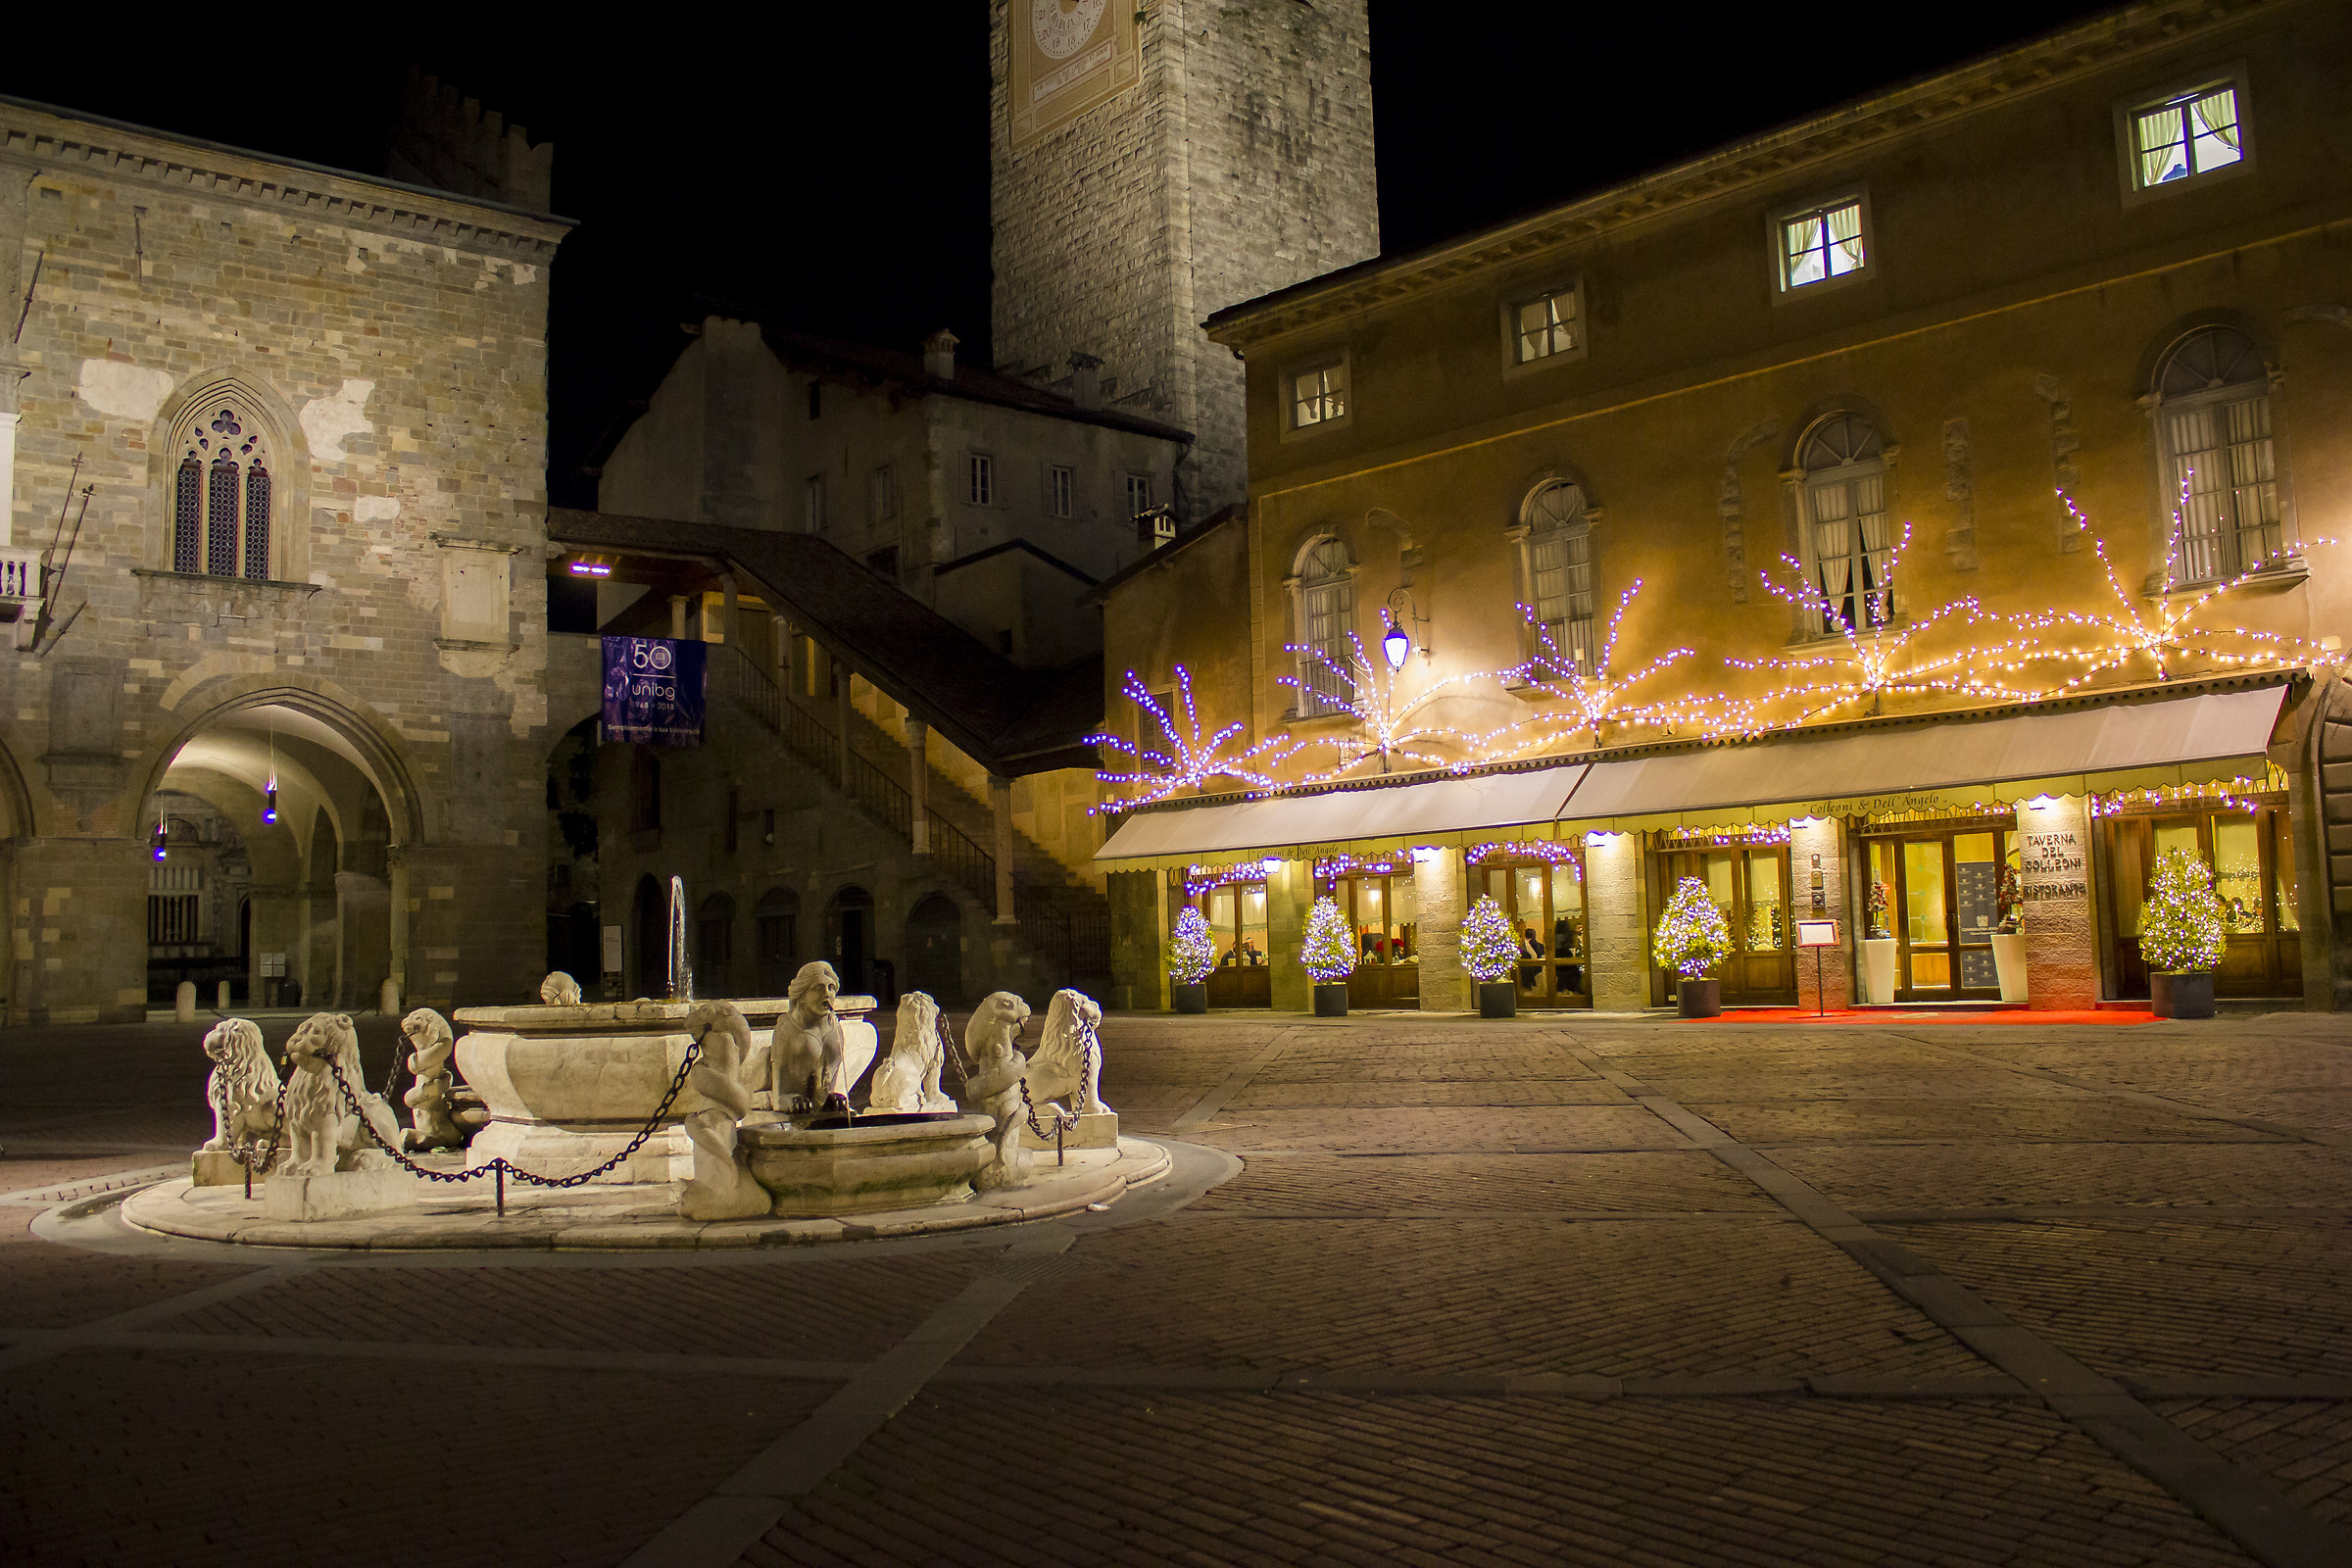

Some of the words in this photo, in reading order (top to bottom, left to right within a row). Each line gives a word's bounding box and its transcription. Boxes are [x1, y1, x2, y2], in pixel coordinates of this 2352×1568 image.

[1083, 18, 1091, 30] 17
[1053, 37, 1060, 49] 19
[633, 644, 671, 669] 50
[632, 682, 675, 701] unibg
[1809, 801, 1853, 814] Colleoni
[1858, 800, 1869, 810] &
[2027, 833, 2077, 847] TAVERNA
[2041, 846, 2065, 858] DEL
[2026, 858, 2082, 873] COLLEONI
[2023, 882, 2087, 901] RISTORANTE
